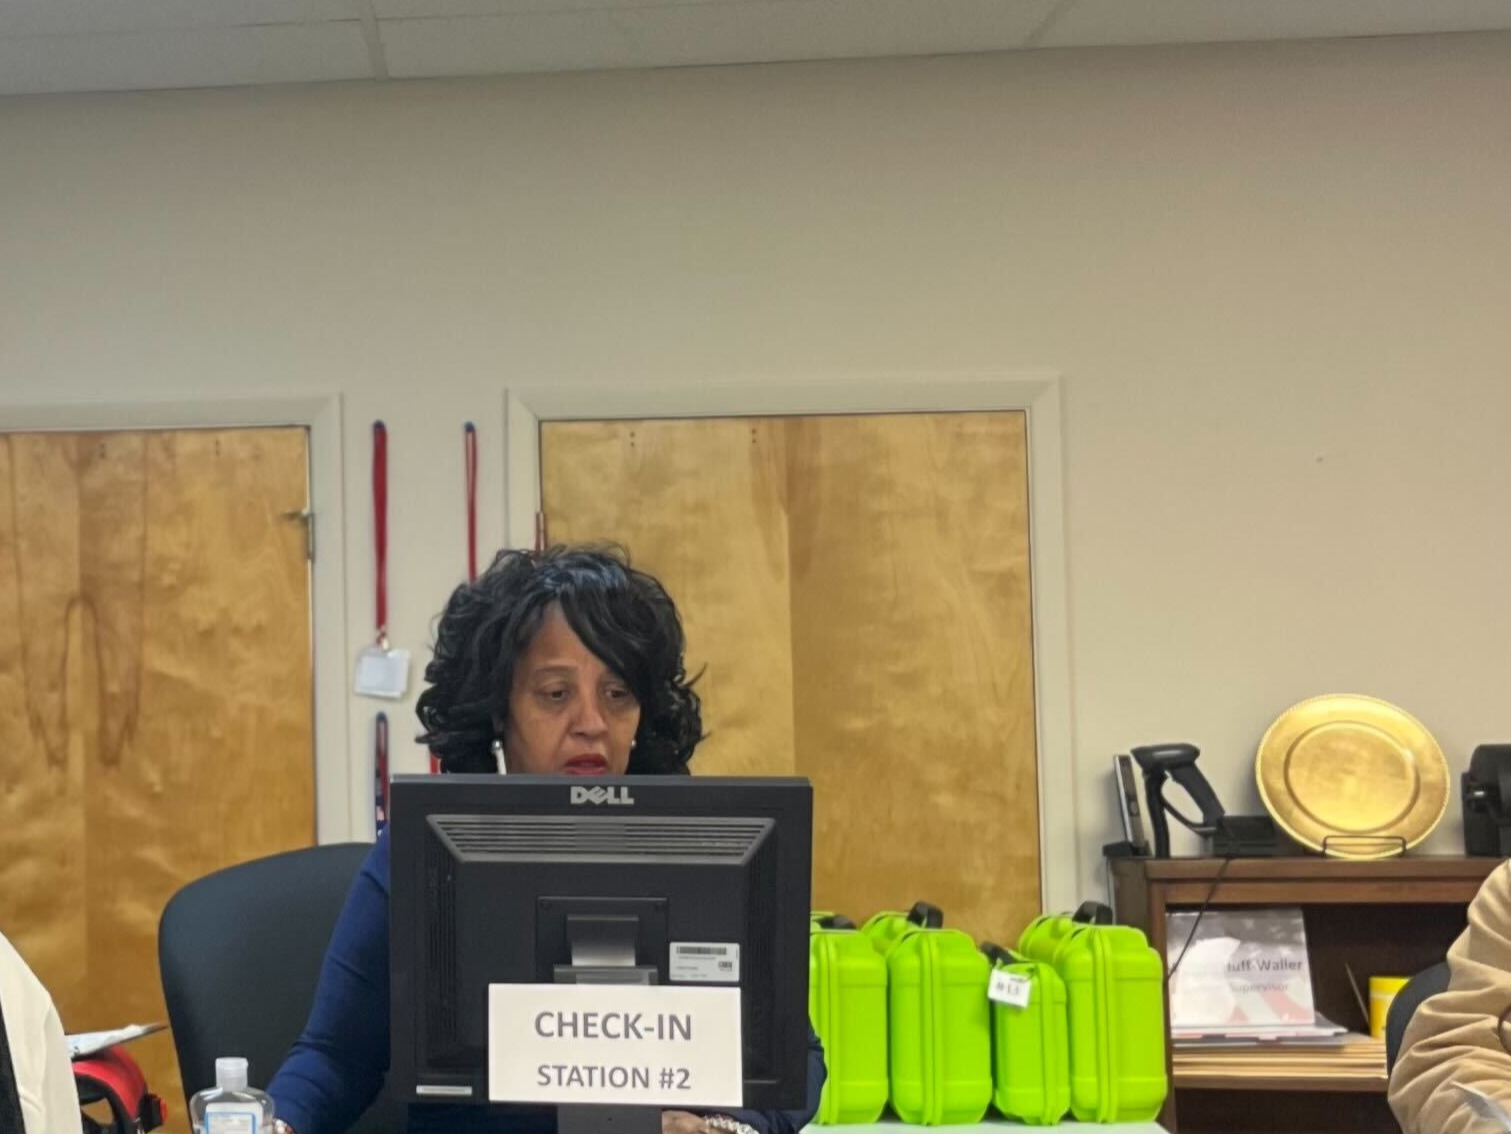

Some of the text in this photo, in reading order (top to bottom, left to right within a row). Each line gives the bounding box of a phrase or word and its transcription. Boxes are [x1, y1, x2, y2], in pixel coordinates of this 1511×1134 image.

[570, 786, 634, 804] DELL
[534, 1011, 692, 1040] CHECK-IN
[537, 1064, 691, 1090] STATION #2
